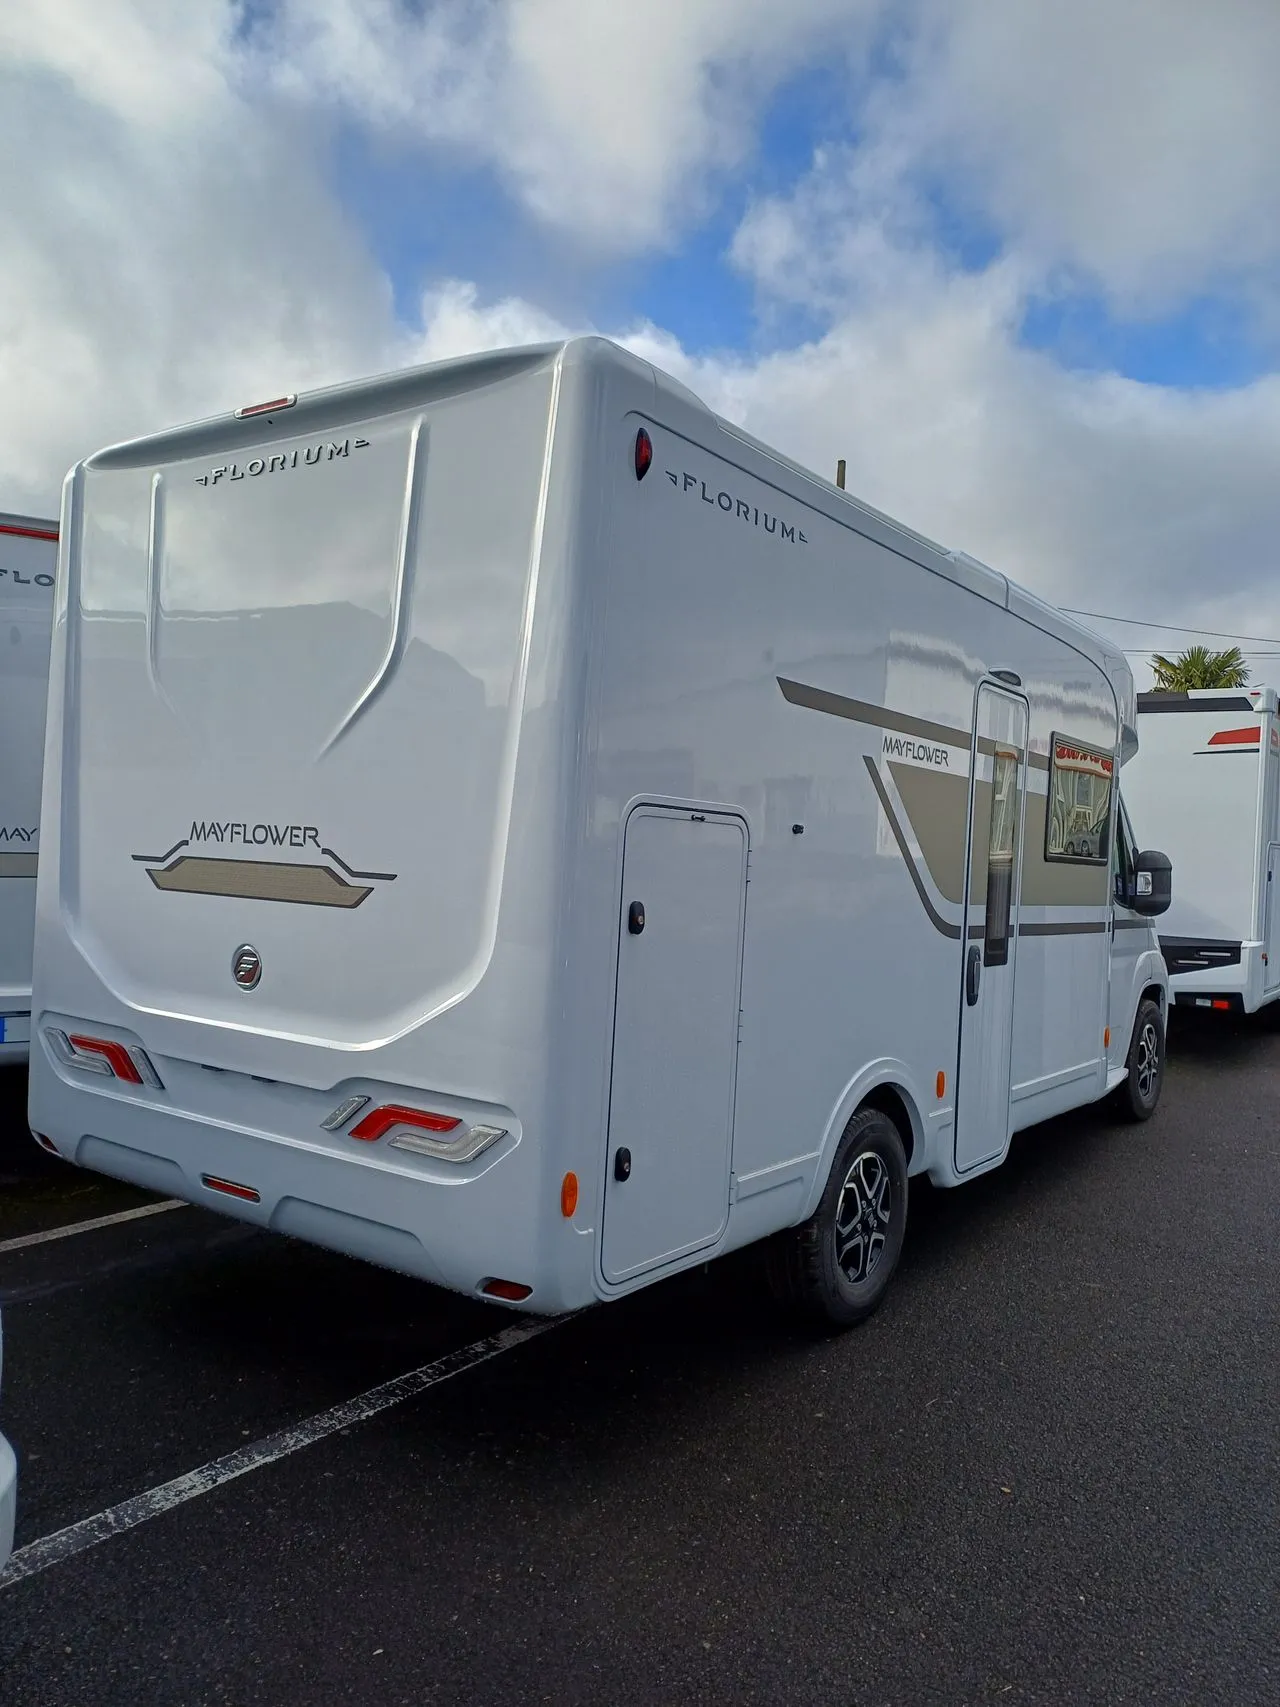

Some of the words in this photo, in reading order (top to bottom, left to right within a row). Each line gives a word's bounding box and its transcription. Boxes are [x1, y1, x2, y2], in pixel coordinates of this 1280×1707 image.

[211, 439, 349, 485] FLORIUM
[683, 472, 795, 543] FLORIUM
[882, 736, 949, 767] MAYFLOWER
[189, 821, 321, 848] MAYFLOWER
